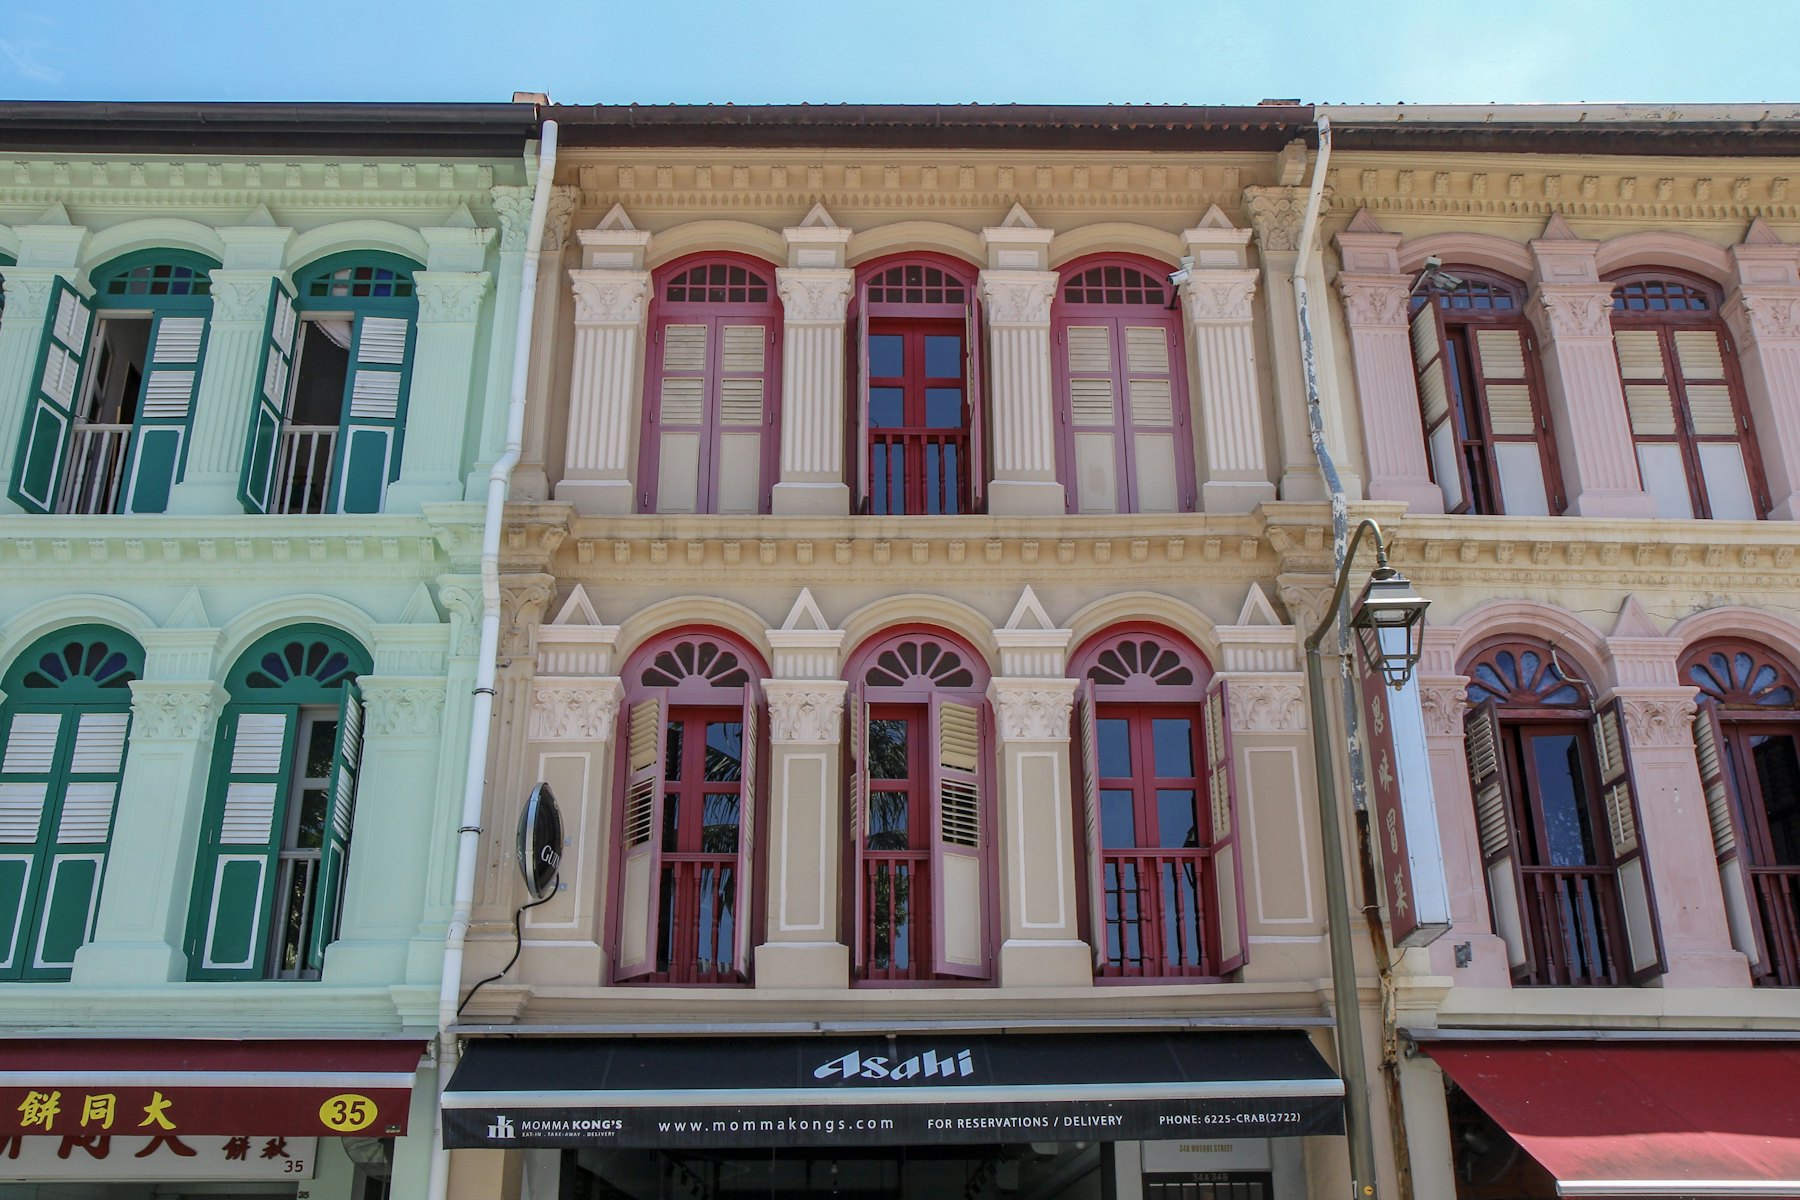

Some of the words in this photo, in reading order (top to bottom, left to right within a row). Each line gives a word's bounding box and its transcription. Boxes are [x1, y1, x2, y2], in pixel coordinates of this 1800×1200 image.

[813, 1049, 974, 1081] Asahi
[331, 1101, 366, 1125] 35
[1159, 1115, 1202, 1125] PHONE:
[1204, 1112, 1301, 1124] 6225-CRAB(2722)
[521, 1120, 570, 1130] MOMMA
[572, 1120, 623, 1130] KONG'S
[658, 1117, 894, 1133] www.mommakongs.com
[928, 1119, 952, 1129] FOR
[957, 1117, 1049, 1129] RESERVATIONS
[1064, 1115, 1123, 1127] DELIVERY
[1191, 1144, 1213, 1153] MOSQUE
[1214, 1144, 1233, 1153] STREET
[284, 1160, 304, 1173] 35
[298, 1190, 310, 1199] 35
